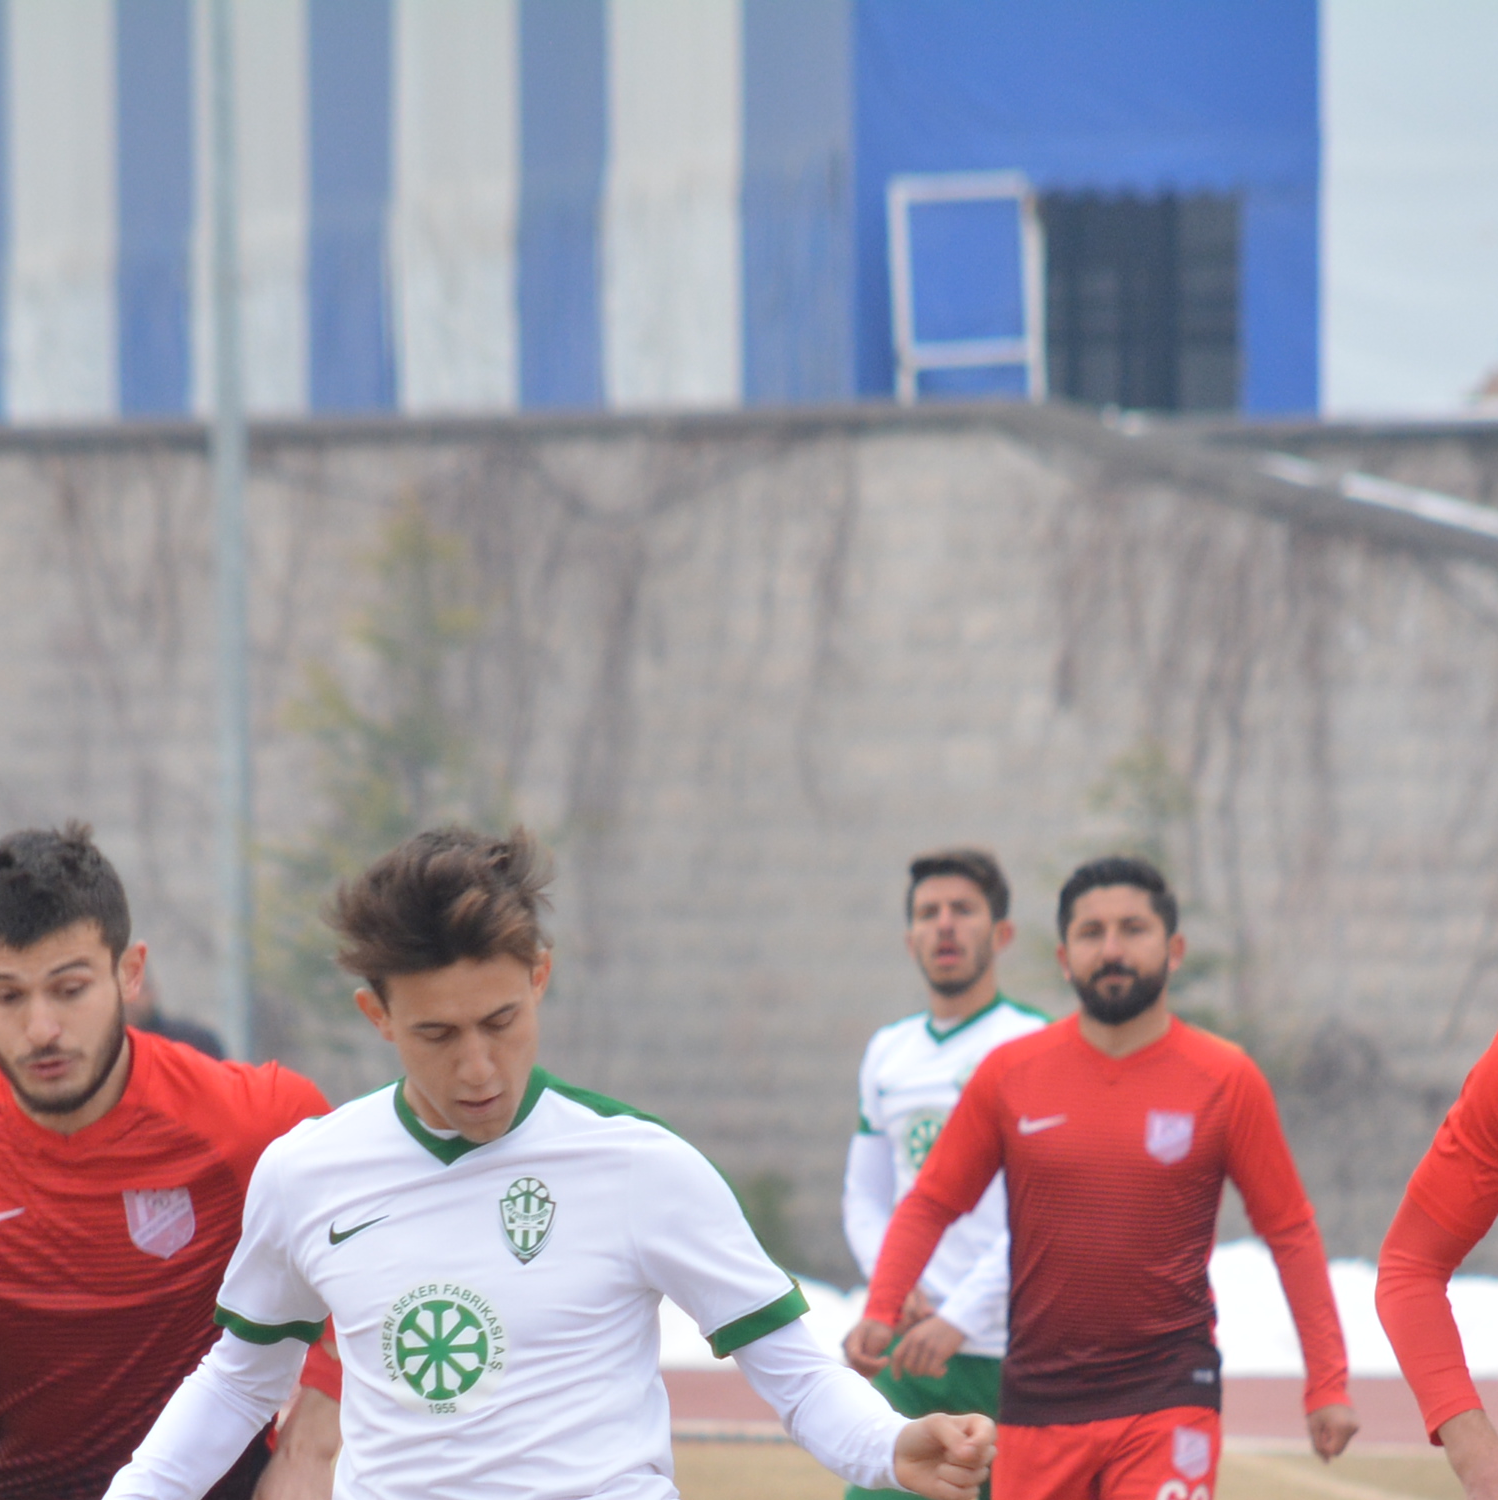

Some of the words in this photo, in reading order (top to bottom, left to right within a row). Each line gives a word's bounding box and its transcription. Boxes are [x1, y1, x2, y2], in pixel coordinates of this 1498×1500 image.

[382, 1314, 399, 1381] KAYSERİ
[392, 1284, 438, 1316] ŞEKER
[443, 1284, 504, 1341] FABRİKASI
[428, 1402, 457, 1414] 1955
